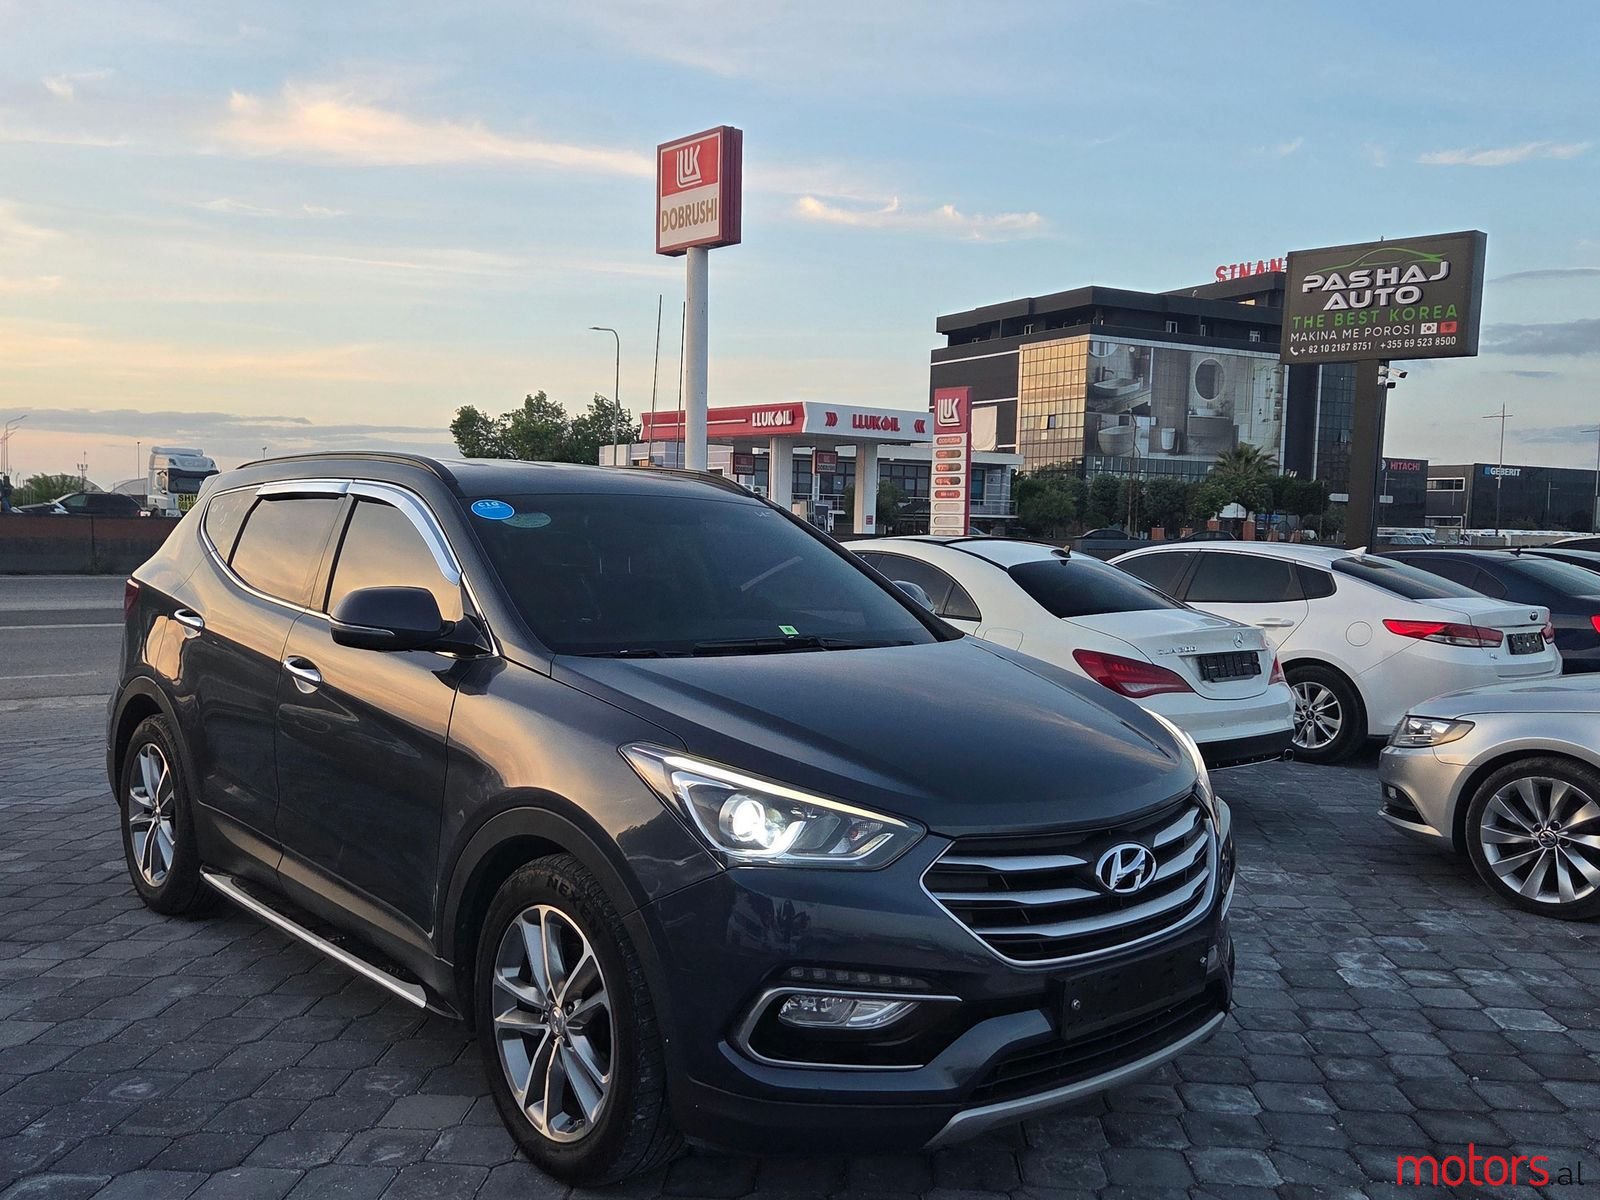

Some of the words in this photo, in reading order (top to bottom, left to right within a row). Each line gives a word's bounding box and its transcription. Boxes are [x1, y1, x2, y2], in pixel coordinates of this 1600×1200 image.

[661, 197, 718, 233] DOBRUSHI
[1302, 260, 1450, 293] PASHAJ
[1322, 285, 1424, 311] AUTO
[1293, 314, 1325, 329] THE
[1334, 310, 1380, 327] BEST
[1389, 304, 1457, 322] KOREA
[1290, 330, 1338, 343] MAKINA
[1342, 328, 1360, 339] ME
[1364, 324, 1416, 338] POROSI
[1320, 345, 1330, 353] 10
[1331, 343, 1351, 352] 2187
[1352, 341, 1372, 351] 8751
[1380, 340, 1402, 349] +355
[1404, 338, 1415, 348] 69
[1416, 337, 1433, 347] 523
[1434, 336, 1457, 346] 8500
[752, 410, 793, 427] LLUKOIL
[851, 413, 901, 432] LLUKOIL
[1390, 462, 1421, 472] HITACHI
[1490, 467, 1521, 477] GEBERIT
